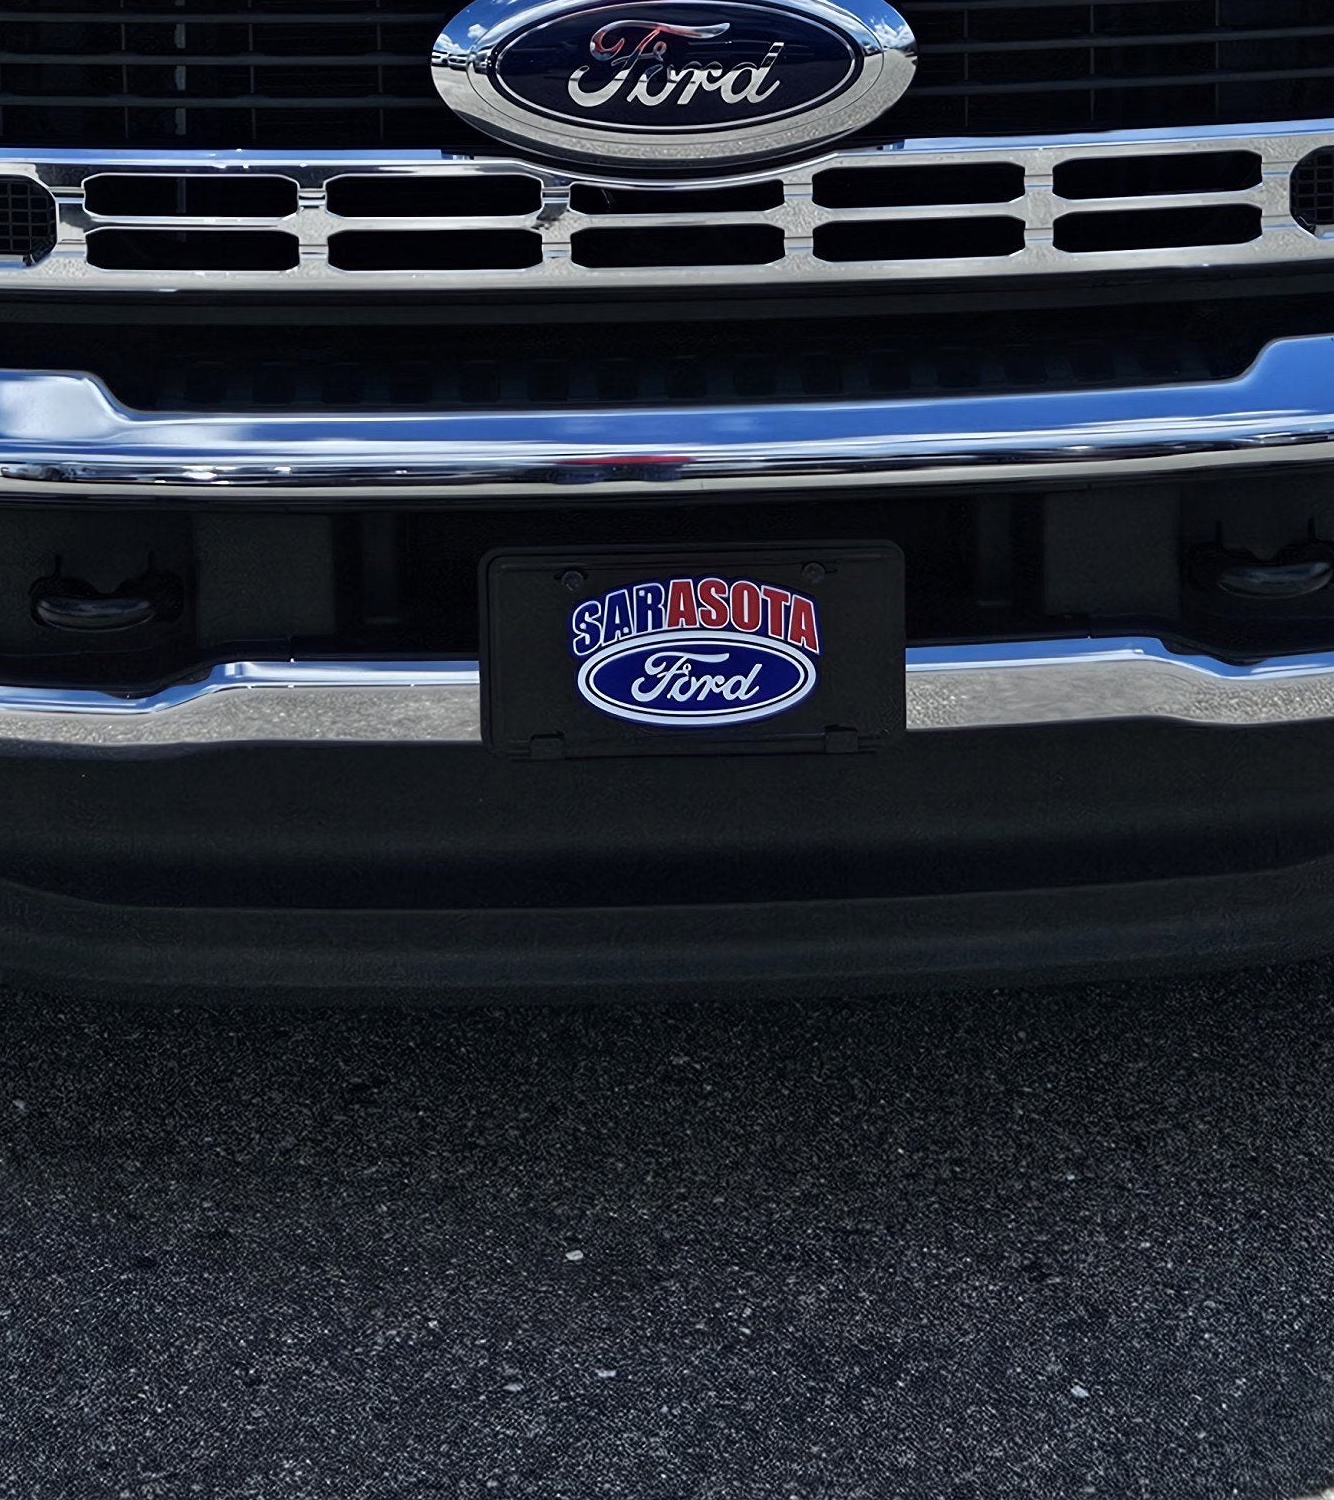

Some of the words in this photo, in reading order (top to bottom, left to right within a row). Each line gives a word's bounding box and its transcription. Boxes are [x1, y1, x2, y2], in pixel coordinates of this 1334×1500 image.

[567, 19, 784, 108] Ford
[571, 577, 821, 657] SARASOTA
[630, 650, 761, 703] Ford
